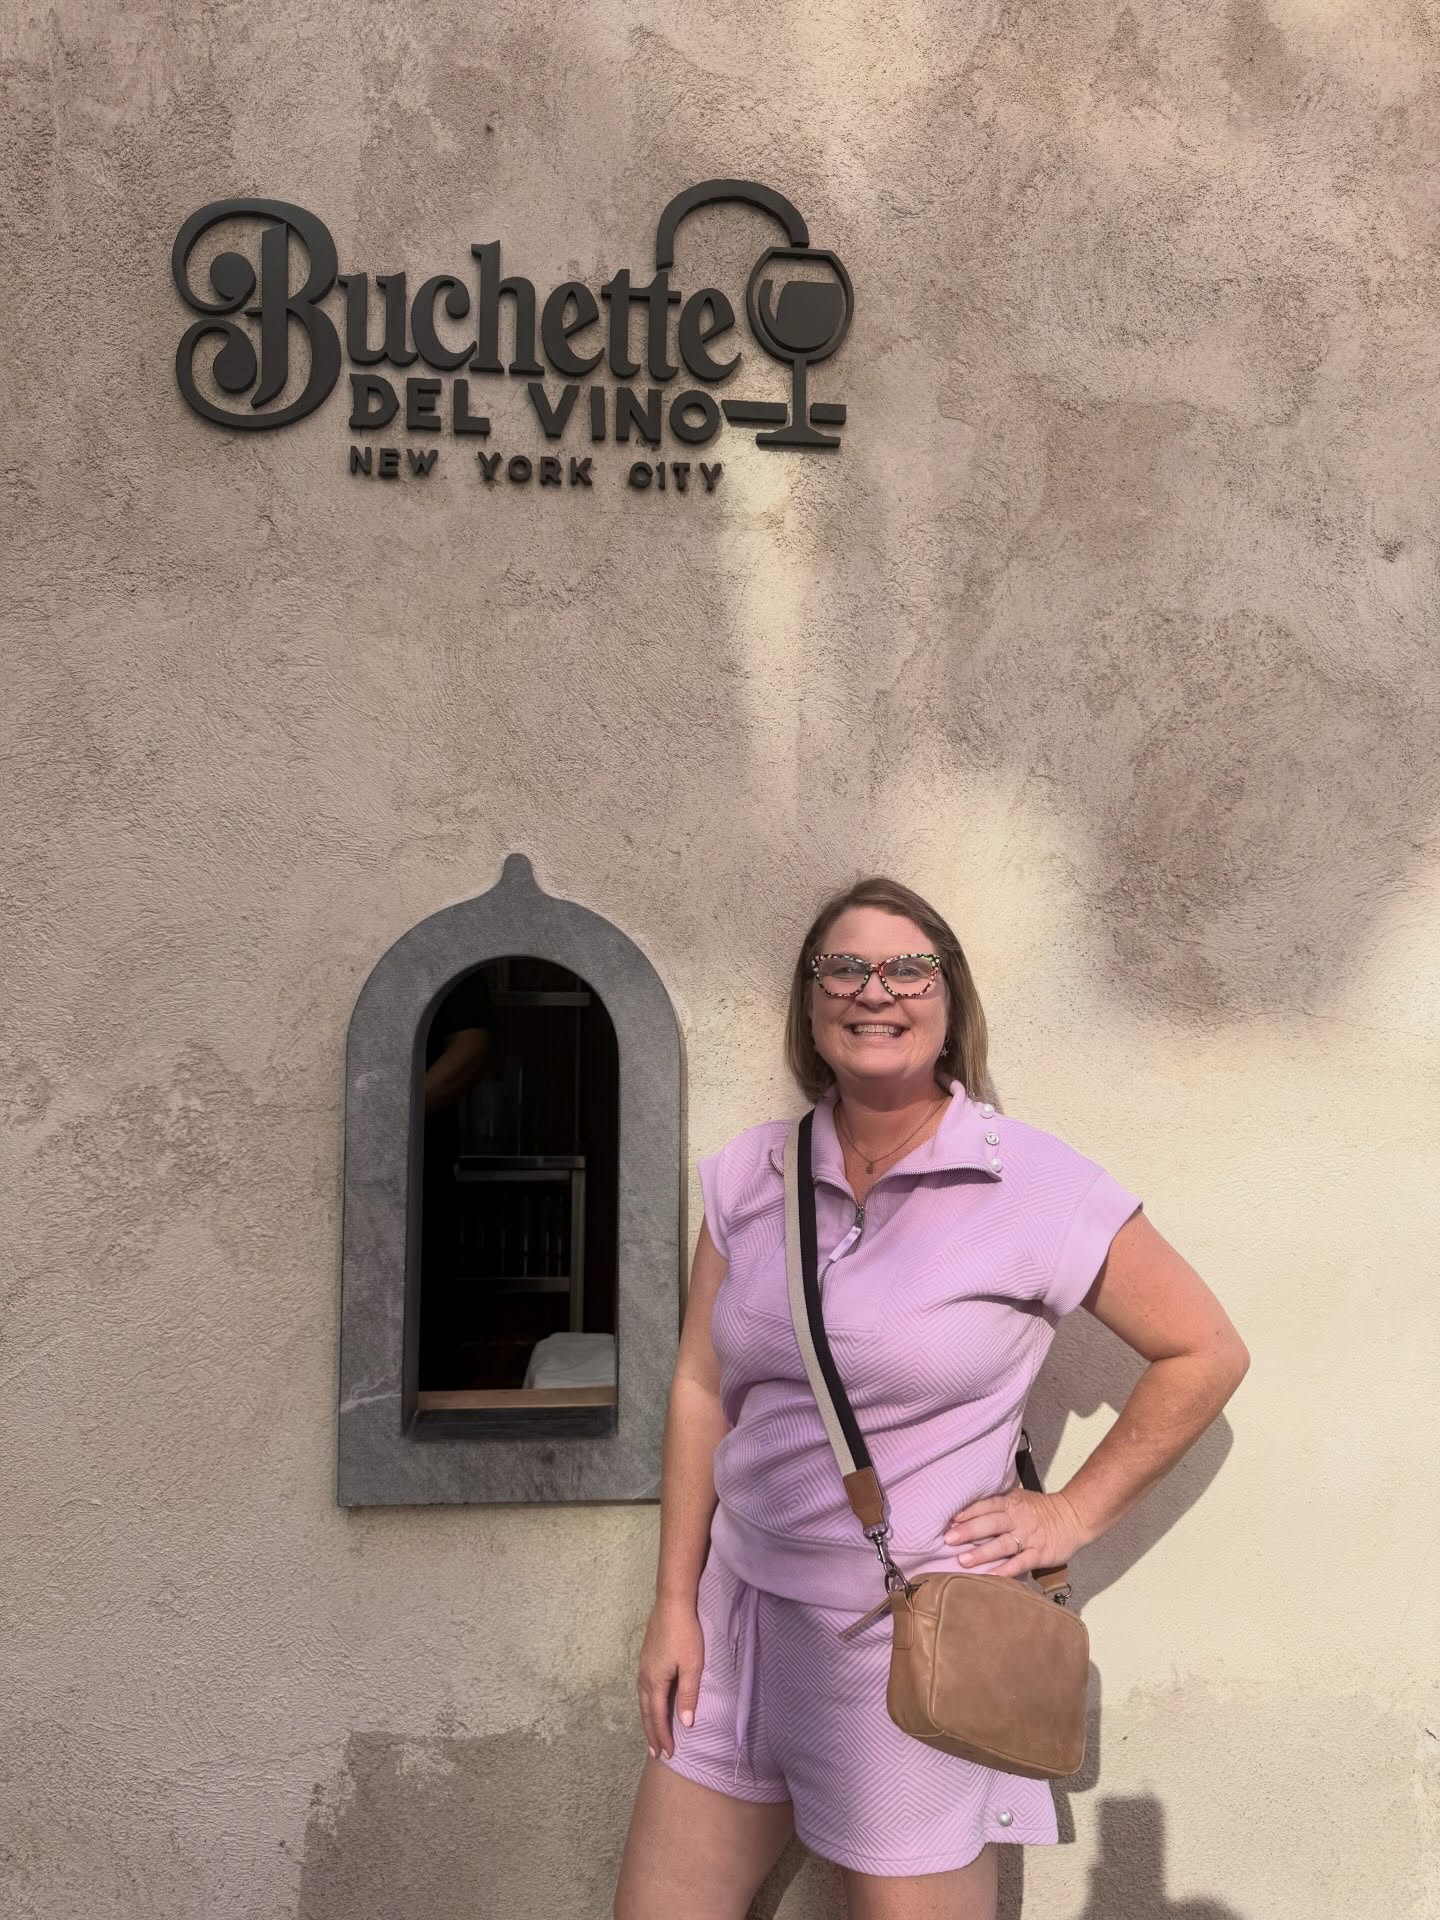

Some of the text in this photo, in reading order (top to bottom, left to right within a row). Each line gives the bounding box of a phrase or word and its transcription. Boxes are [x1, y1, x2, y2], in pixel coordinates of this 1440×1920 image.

[171, 197, 742, 431] Buchette
[349, 373, 721, 444] DEL VINO
[349, 446, 723, 491] NEW YORK CITY
